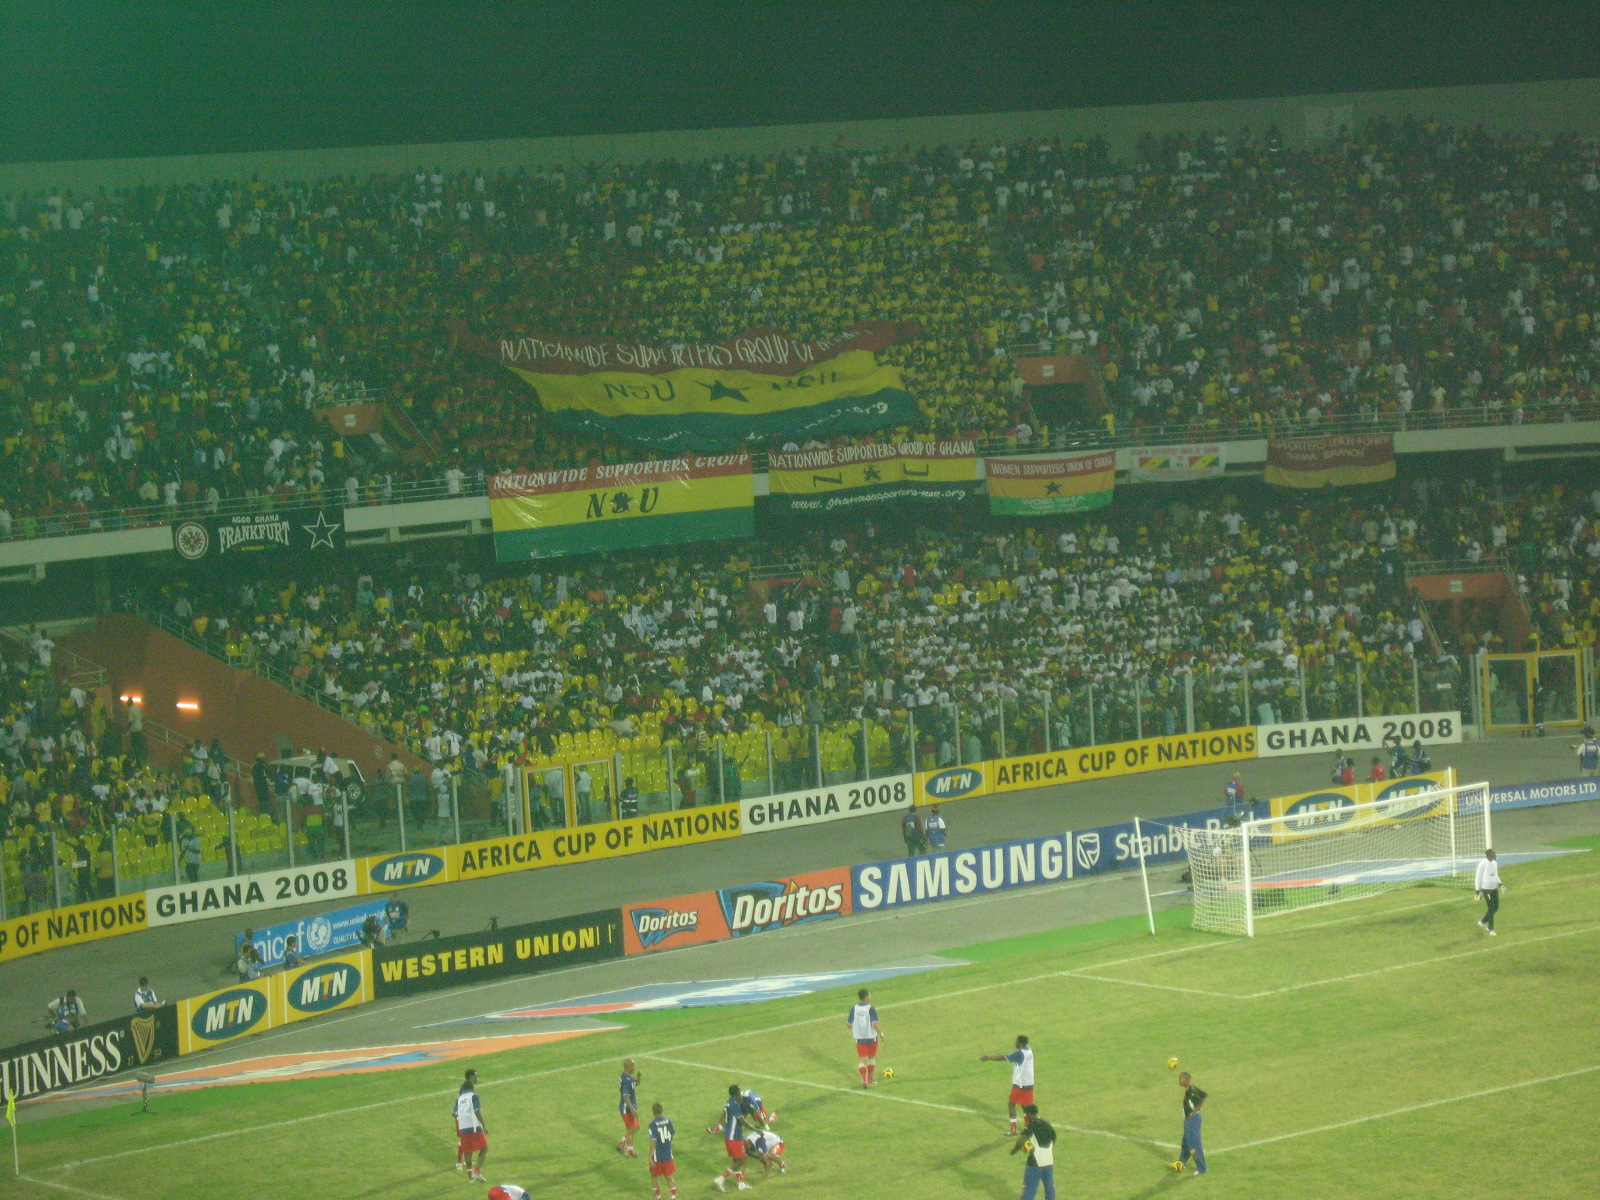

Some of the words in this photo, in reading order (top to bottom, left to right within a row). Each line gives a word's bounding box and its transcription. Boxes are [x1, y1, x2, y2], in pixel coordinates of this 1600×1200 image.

[735, 334, 789, 364] GROUP
[493, 467, 588, 490] NATIONWIDE
[595, 458, 690, 479] SUPPORTERS
[694, 454, 749, 468] GROUP
[768, 453, 835, 468] NATIONWIDE
[837, 444, 896, 462] SUPPORTERS
[898, 441, 924, 456] GROUP
[925, 442, 936, 455] OF
[939, 440, 976, 455] GHANA
[991, 463, 1020, 475] WOMEN
[1023, 462, 1066, 475] SUPPORTERS
[217, 520, 290, 553] FRANKFURT
[254, 514, 280, 523] GHANA
[1266, 722, 1372, 750] GHANA
[1383, 718, 1453, 741] 2008
[997, 757, 1068, 785] AFRICA
[1078, 750, 1117, 774] CUP
[1124, 745, 1149, 768] OF
[1157, 732, 1255, 763] NATIONS
[936, 771, 973, 795] MTN
[1465, 790, 1527, 807] UNVERSAL
[1530, 784, 1577, 799] MOTORS
[1579, 783, 1597, 794] LTD
[749, 796, 840, 825] GHANA
[848, 781, 907, 810] 2008
[1297, 799, 1343, 827] MTN
[461, 839, 542, 872] AFRICA
[553, 832, 597, 858] CUP
[605, 825, 634, 849] OF
[643, 808, 740, 844] NATIONS
[1115, 822, 1202, 861] Stanbic
[383, 856, 431, 882] MTN
[859, 839, 1063, 908] SAMSUNG
[156, 881, 265, 918] GHANA
[275, 868, 349, 900] 2008
[732, 883, 842, 931] Doritos
[15, 921, 40, 949] OF
[47, 900, 146, 941] NATIONS
[637, 908, 698, 935] Doritos
[381, 943, 503, 982] WESTERN
[515, 927, 596, 959] UNION
[300, 969, 348, 1006] MTN
[205, 995, 254, 1034] MTN
[0, 1031, 122, 1101] UINNESS
[657, 1126, 672, 1144] 14
